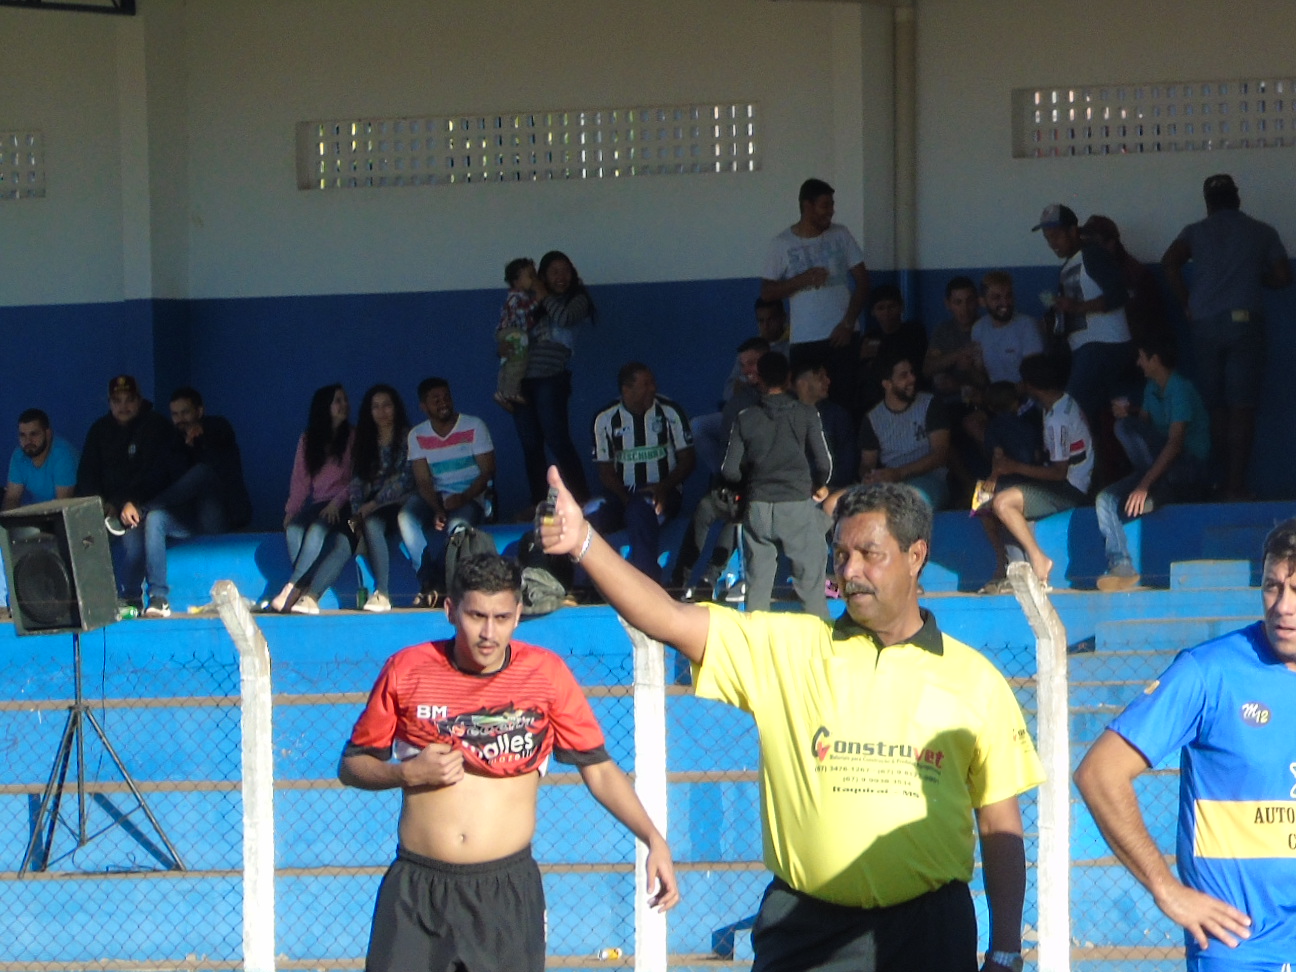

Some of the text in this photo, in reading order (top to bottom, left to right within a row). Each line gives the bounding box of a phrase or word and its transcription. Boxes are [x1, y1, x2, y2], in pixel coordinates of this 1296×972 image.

[416, 704, 448, 721] BM
[811, 725, 945, 768] Construvet
[1254, 806, 1296, 825] AUTO
